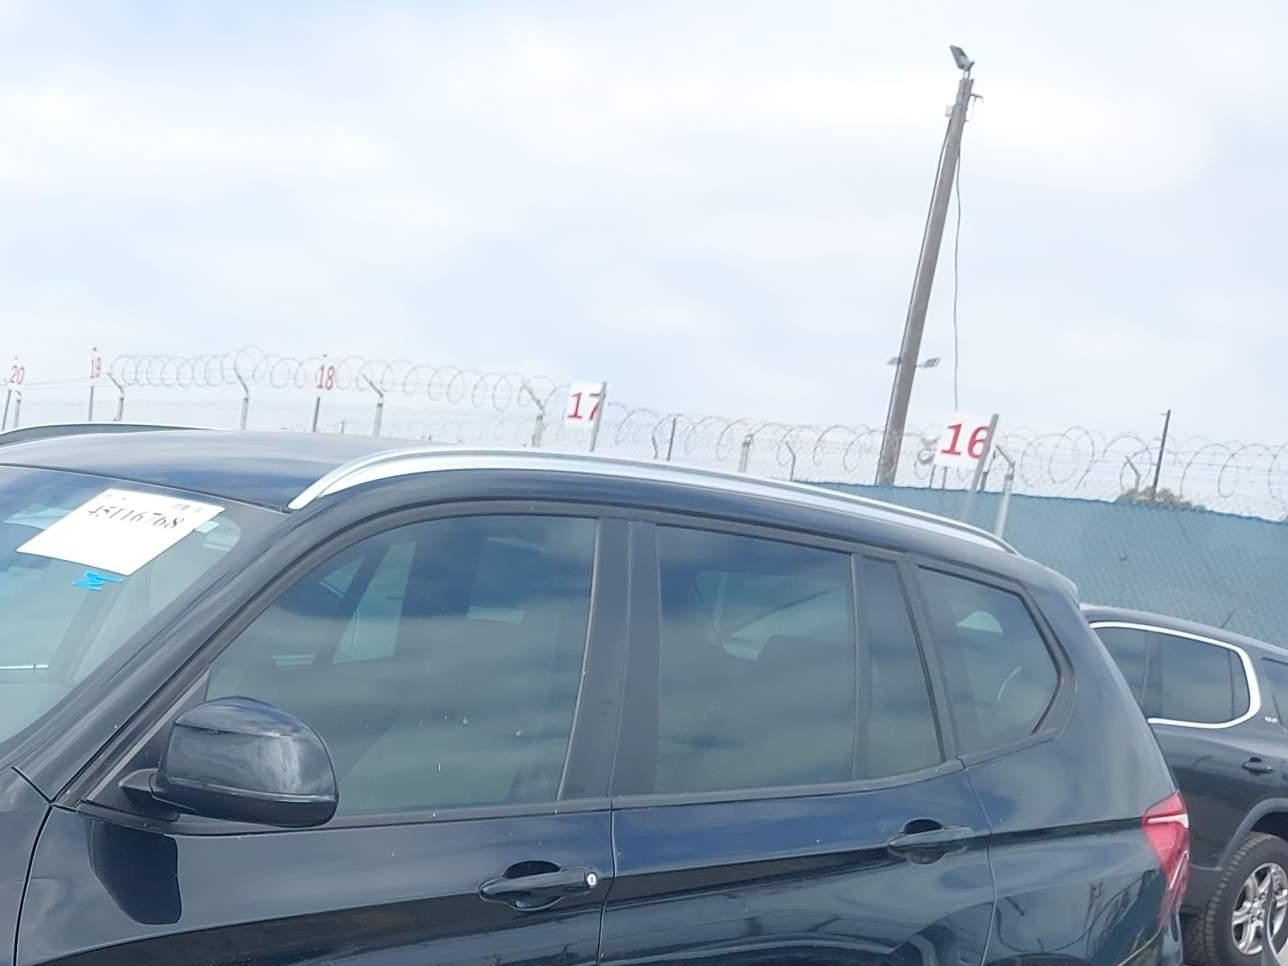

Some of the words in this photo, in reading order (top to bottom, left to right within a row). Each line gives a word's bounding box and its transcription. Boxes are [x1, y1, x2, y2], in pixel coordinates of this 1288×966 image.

[9, 364, 25, 385] 20
[316, 364, 335, 391] 18
[567, 391, 606, 421] 17
[940, 422, 992, 459] 16
[88, 504, 185, 529] 45116768
